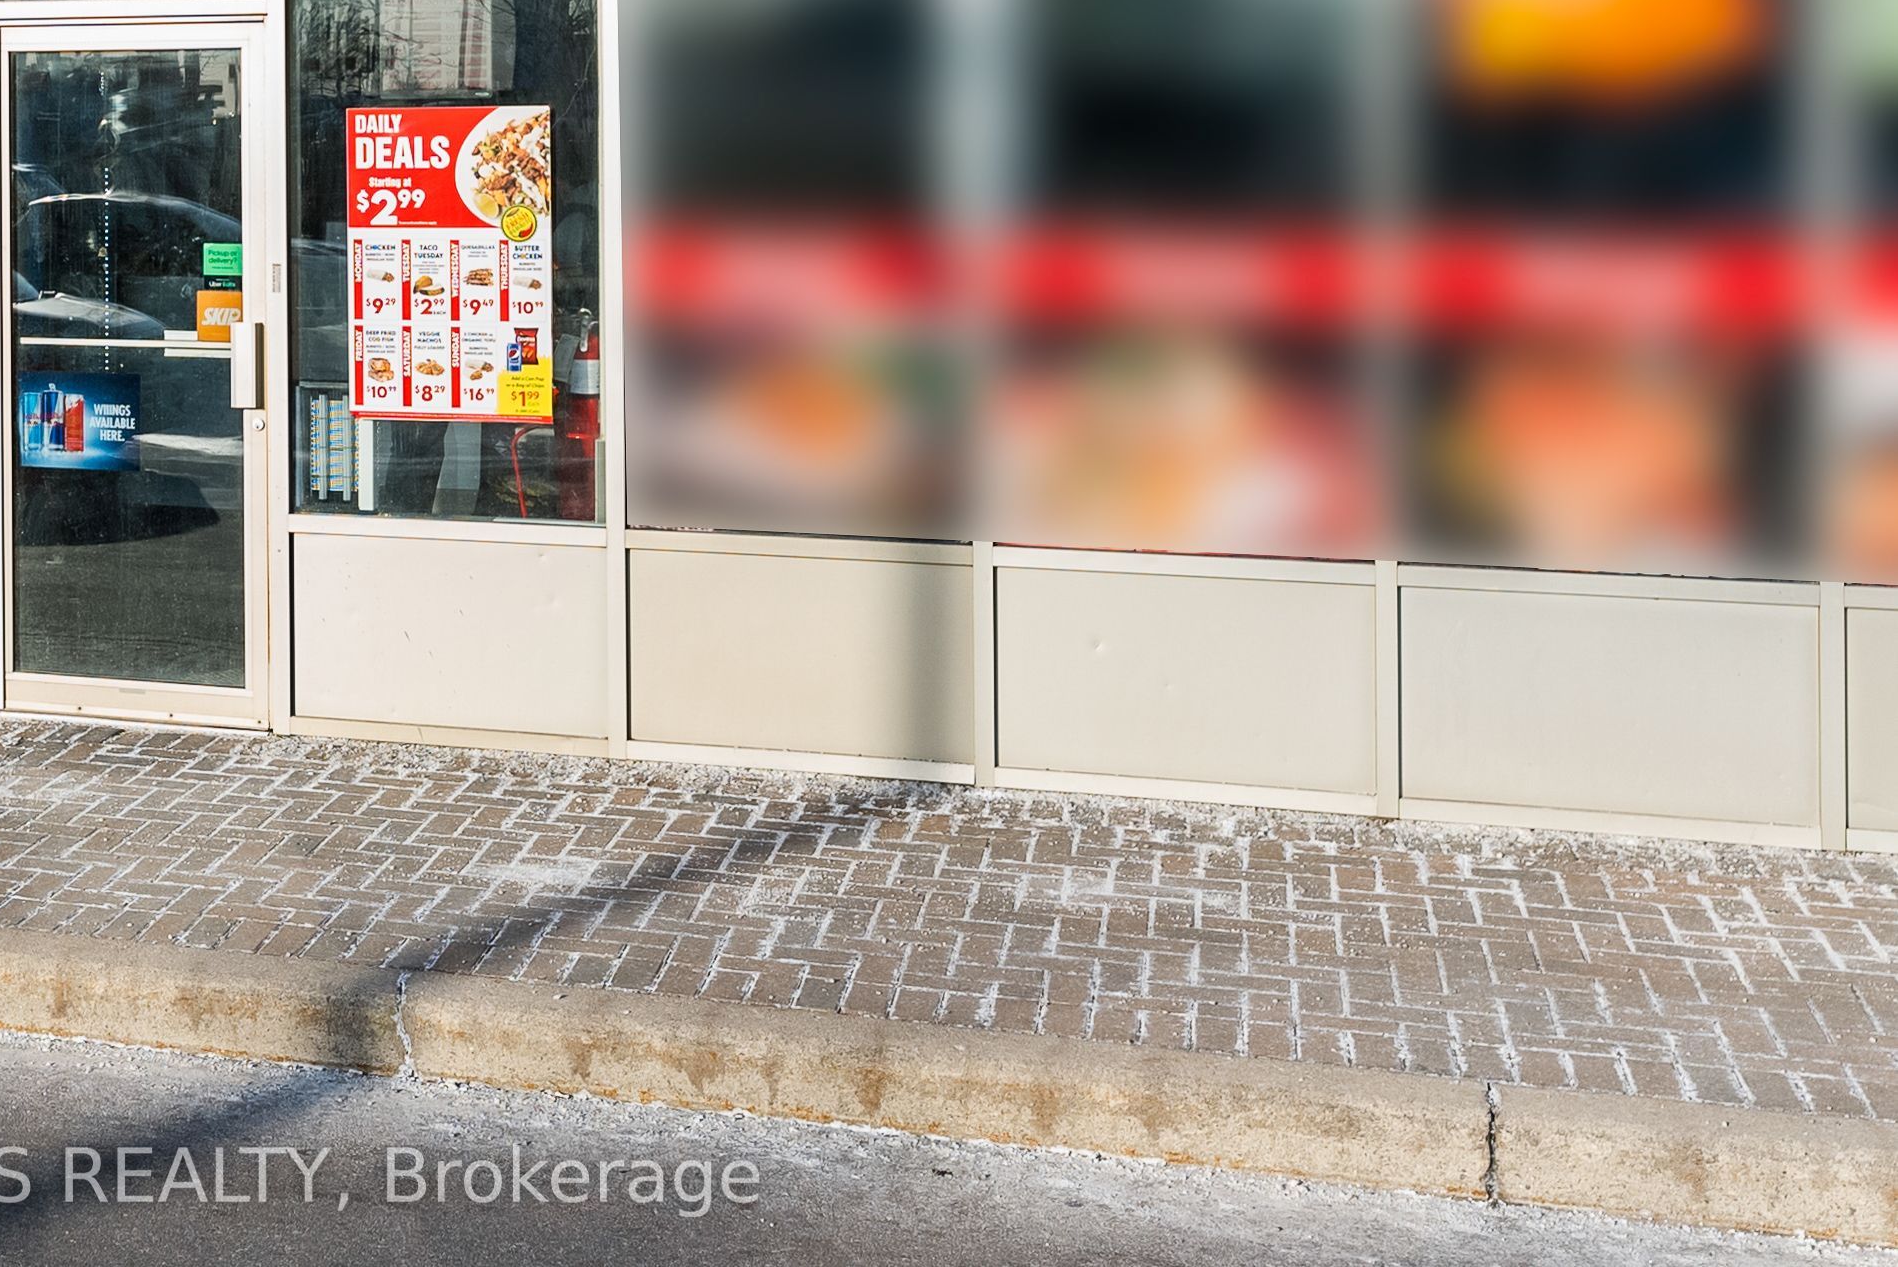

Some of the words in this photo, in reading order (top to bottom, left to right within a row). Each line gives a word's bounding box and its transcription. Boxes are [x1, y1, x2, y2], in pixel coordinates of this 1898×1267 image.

[355, 114, 402, 134] DAILY
[355, 135, 450, 170] DEALS
[368, 176, 401, 188] Starting
[403, 177, 412, 187] at
[208, 249, 230, 257] Pickup
[208, 257, 238, 265] delivery?
[354, 242, 363, 283] MONDAY
[402, 242, 411, 283] TUESDAY
[500, 243, 509, 291] THURSDAY
[451, 243, 459, 299] WEDNESDAY
[201, 307, 241, 326] SKIP
[355, 329, 363, 362] FRIDAY
[403, 331, 411, 377] SATURDAY
[452, 331, 460, 368] SUNDAY
[89, 417, 136, 430] AVAILABLE
[100, 430, 125, 442] HERE.
